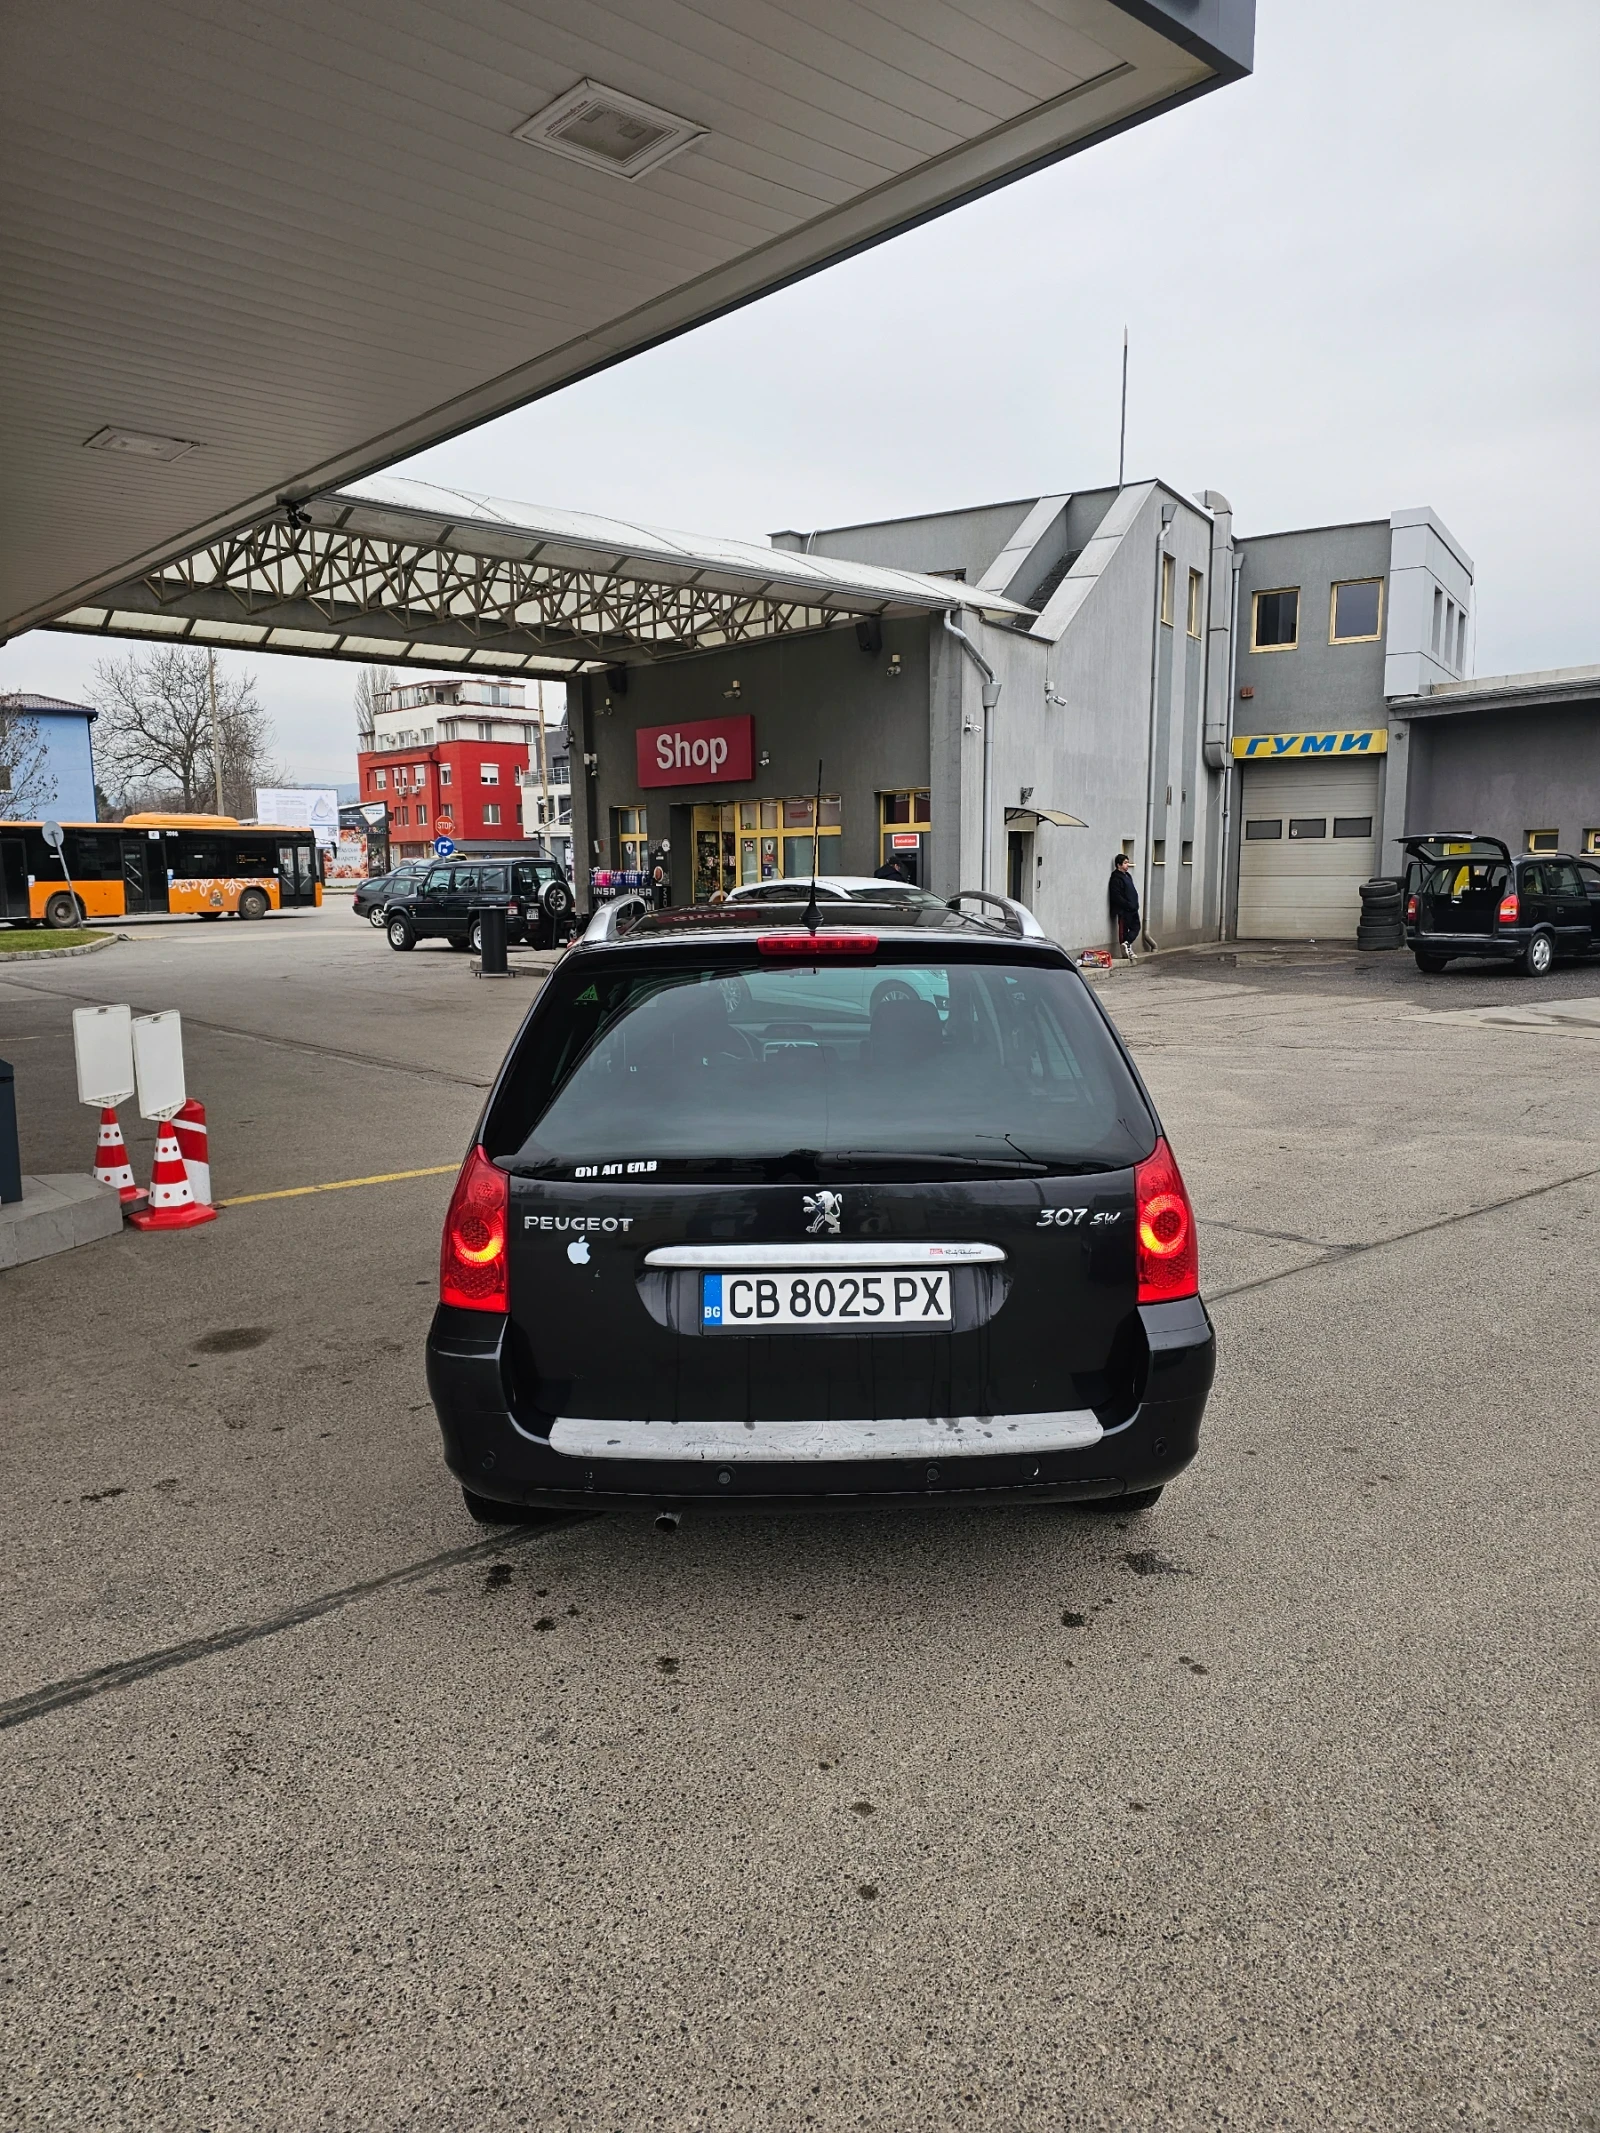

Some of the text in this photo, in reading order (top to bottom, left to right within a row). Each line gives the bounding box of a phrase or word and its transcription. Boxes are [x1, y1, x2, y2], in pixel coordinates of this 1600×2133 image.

[1245, 732, 1373, 755] ГУМИ
[656, 732, 728, 774] Shop
[437, 821, 453, 830] STOP
[593, 887, 652, 897] INSA INSA
[524, 1216, 634, 1232] PEUGEOT
[1036, 1208, 1122, 1227] 307 SW
[729, 1276, 945, 1319] CB 8025 PX
[704, 1306, 721, 1319] BG
